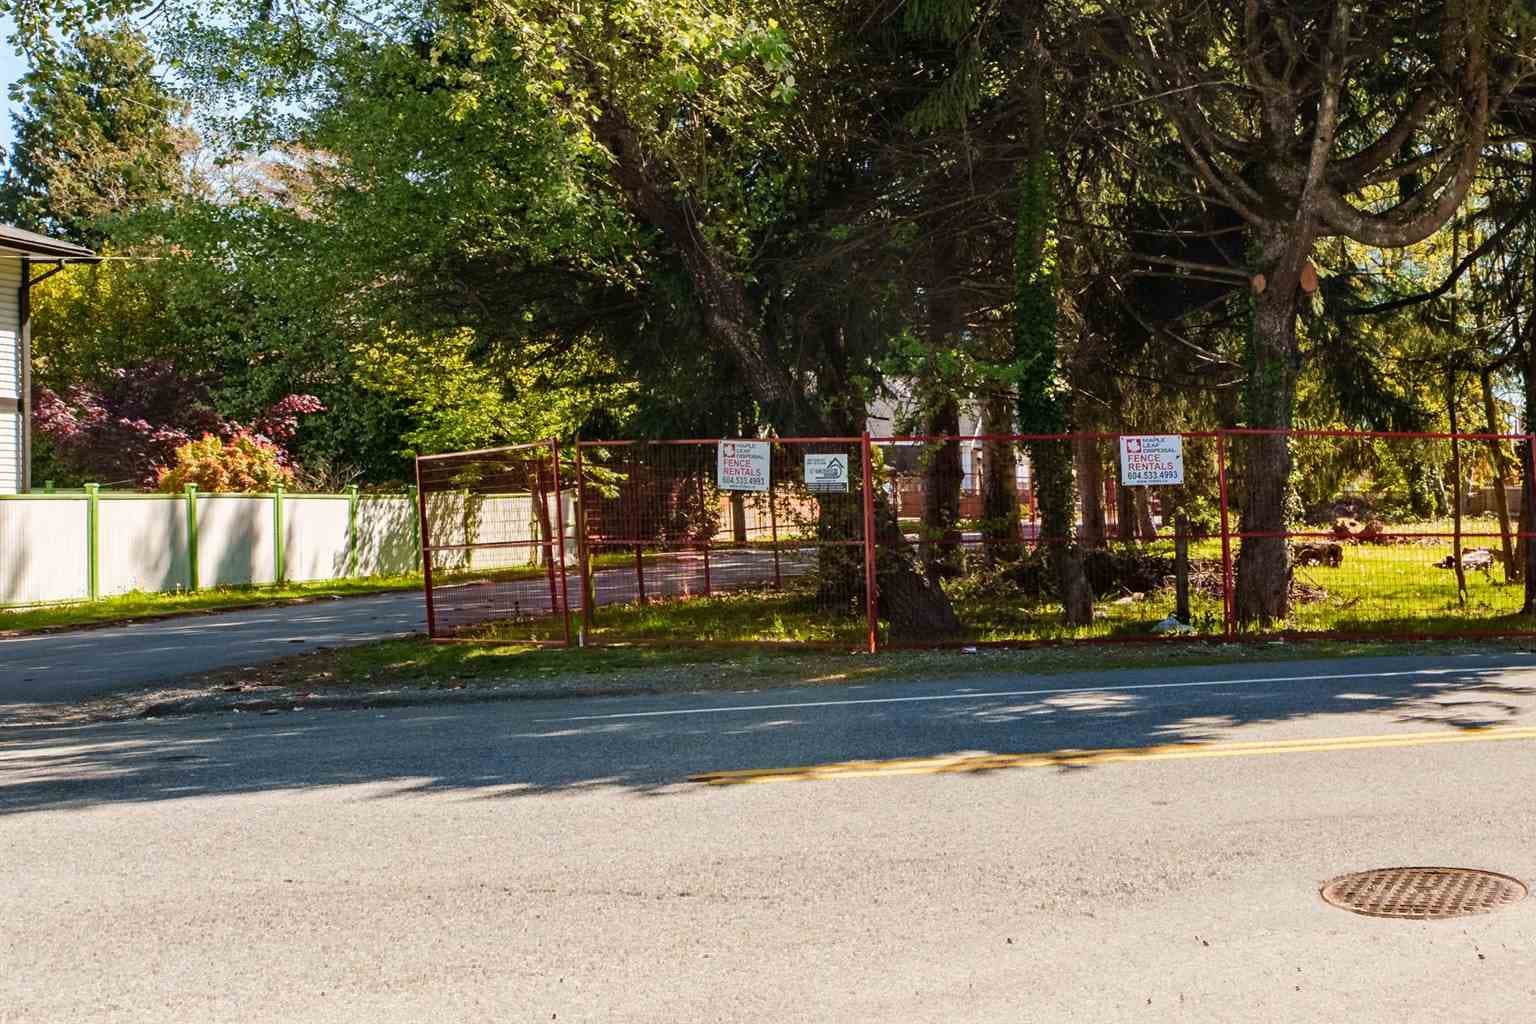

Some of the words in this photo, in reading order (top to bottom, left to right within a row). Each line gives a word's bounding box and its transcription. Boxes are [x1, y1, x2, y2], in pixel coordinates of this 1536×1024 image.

[723, 458, 752, 467] FENCE
[1128, 454, 1160, 462] FENCE
[723, 466, 761, 476] RENTALS
[1128, 463, 1173, 471] RENTALS
[1127, 471, 1178, 480] 604.533.4993
